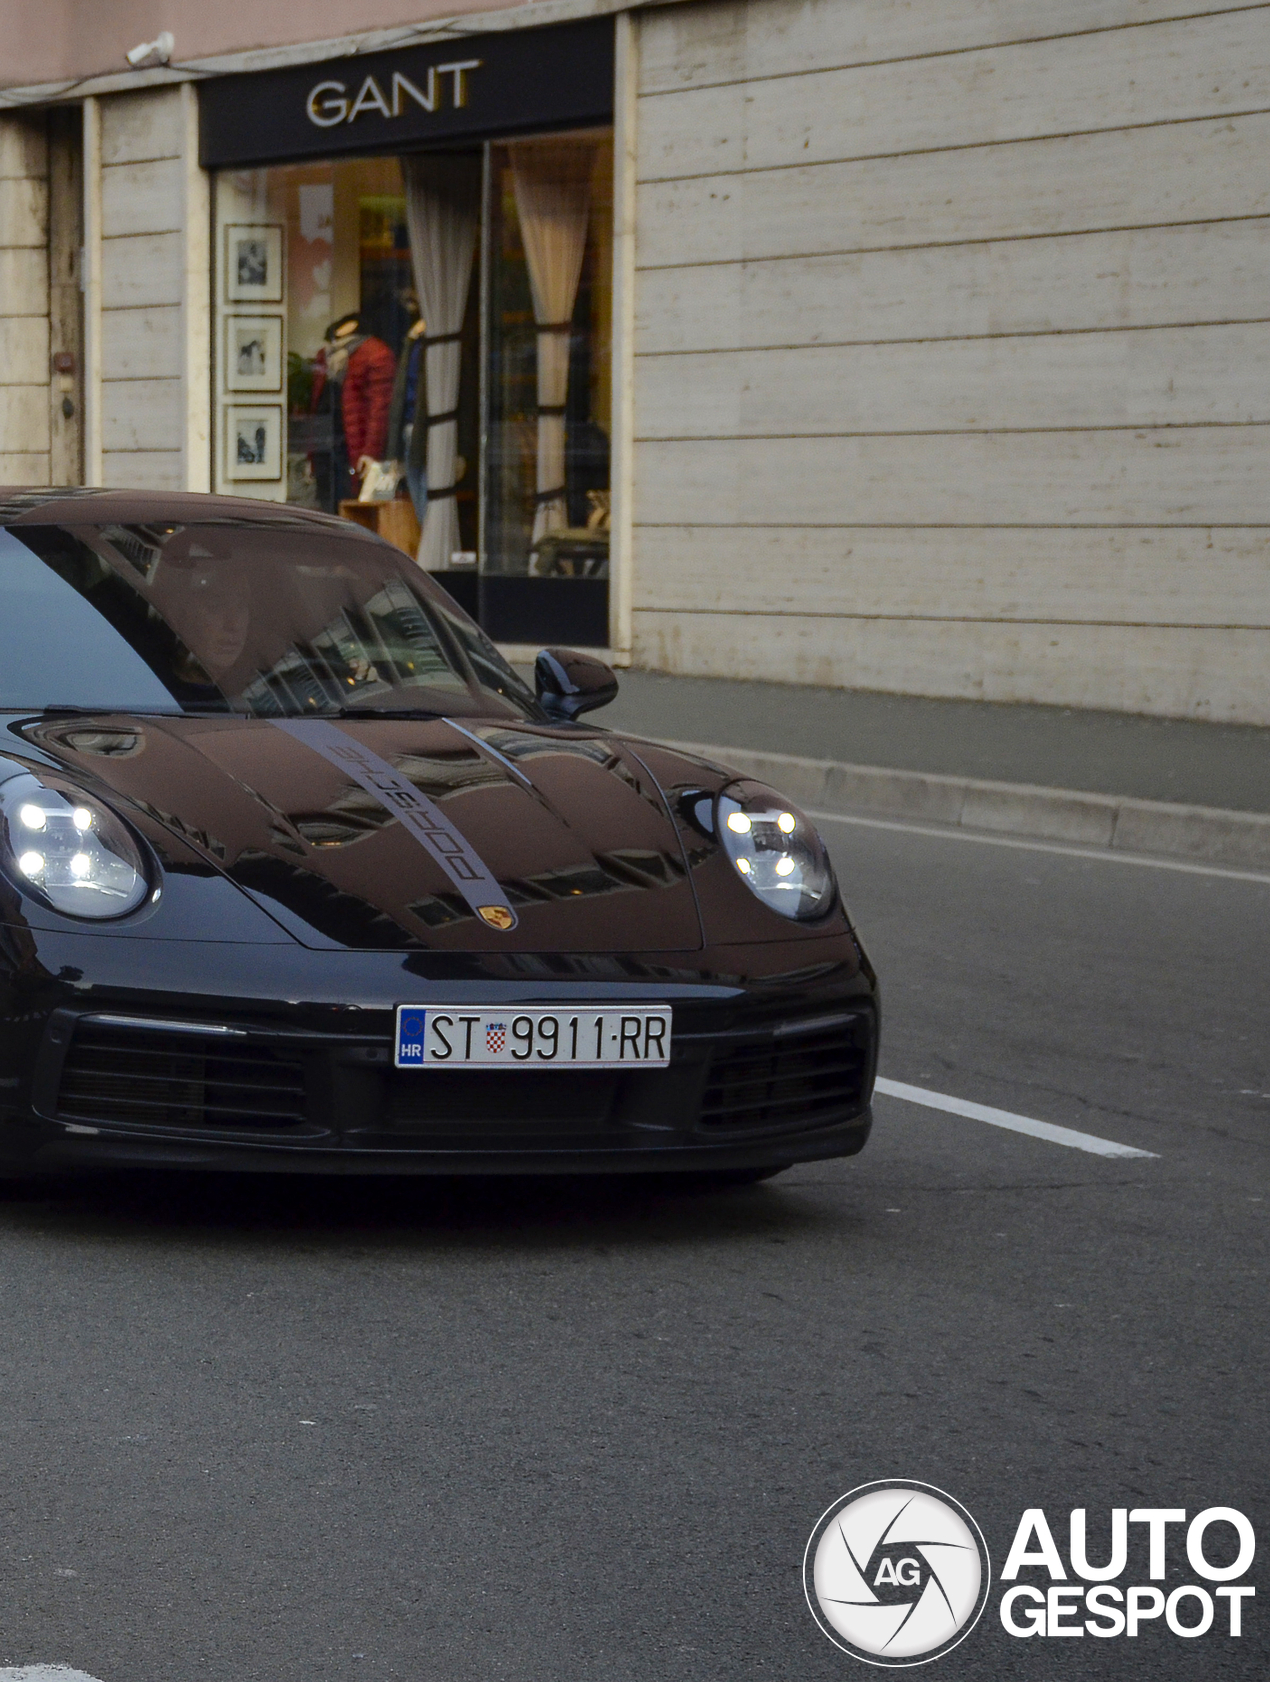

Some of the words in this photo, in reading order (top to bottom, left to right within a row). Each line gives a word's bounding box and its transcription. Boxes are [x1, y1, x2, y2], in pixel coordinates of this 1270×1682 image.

[307, 59, 484, 127] GANT
[327, 744, 486, 880] PORSCHE
[401, 1044, 421, 1057] HR
[430, 1015, 481, 1060] ST
